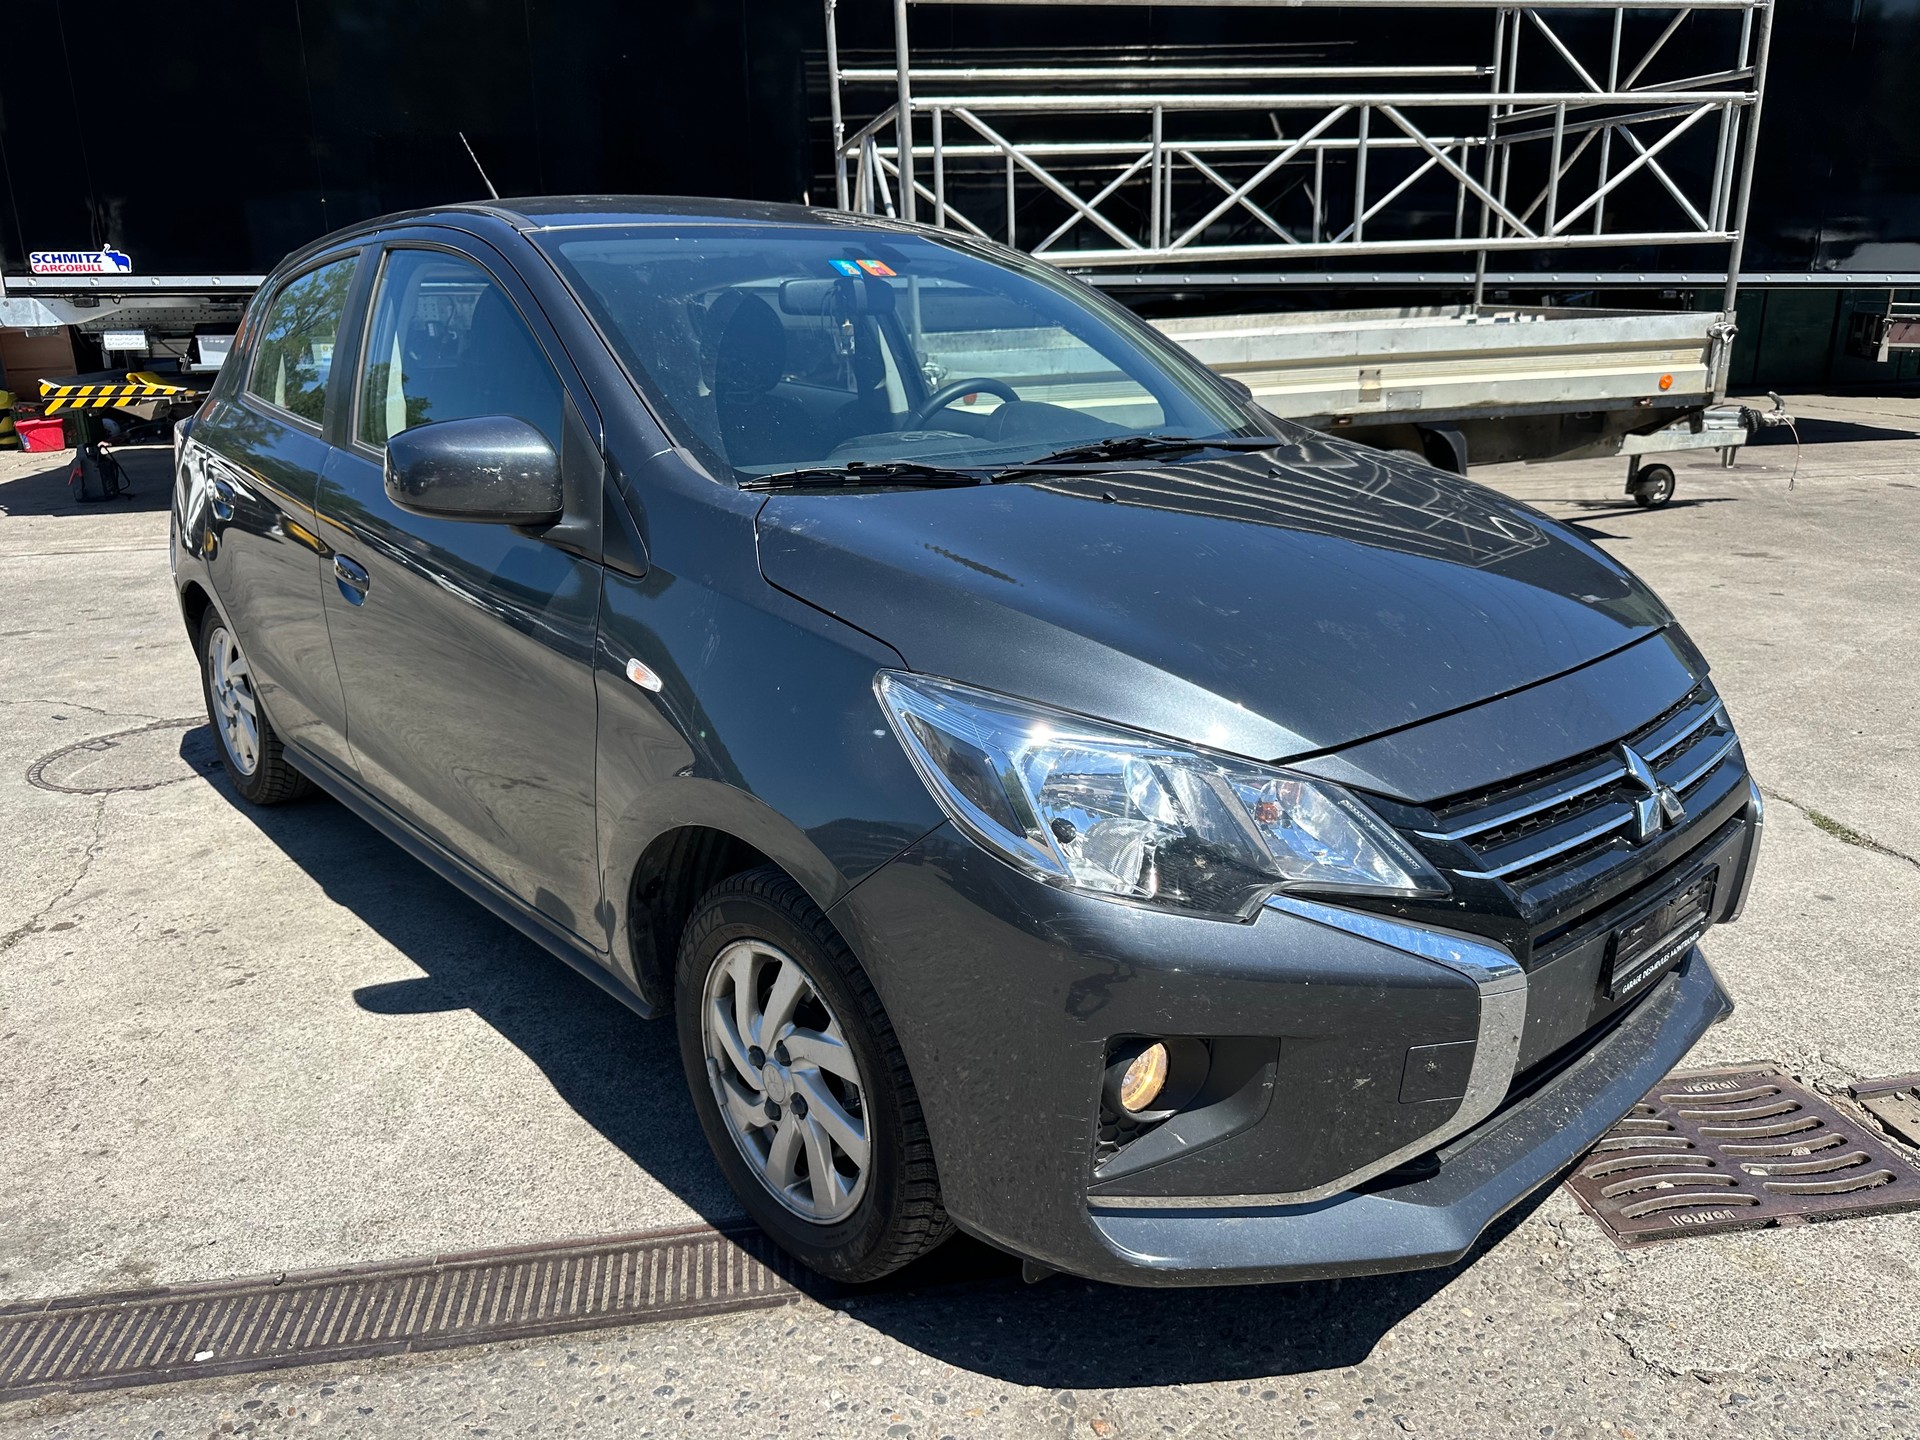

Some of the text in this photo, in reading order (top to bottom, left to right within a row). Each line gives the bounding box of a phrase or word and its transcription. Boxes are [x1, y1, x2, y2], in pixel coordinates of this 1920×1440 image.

[31, 254, 102, 263] SCHMITZ
[33, 264, 104, 272] CARGOBULL
[684, 905, 726, 959] SAVA
[1622, 973, 1642, 994] GARAGE
